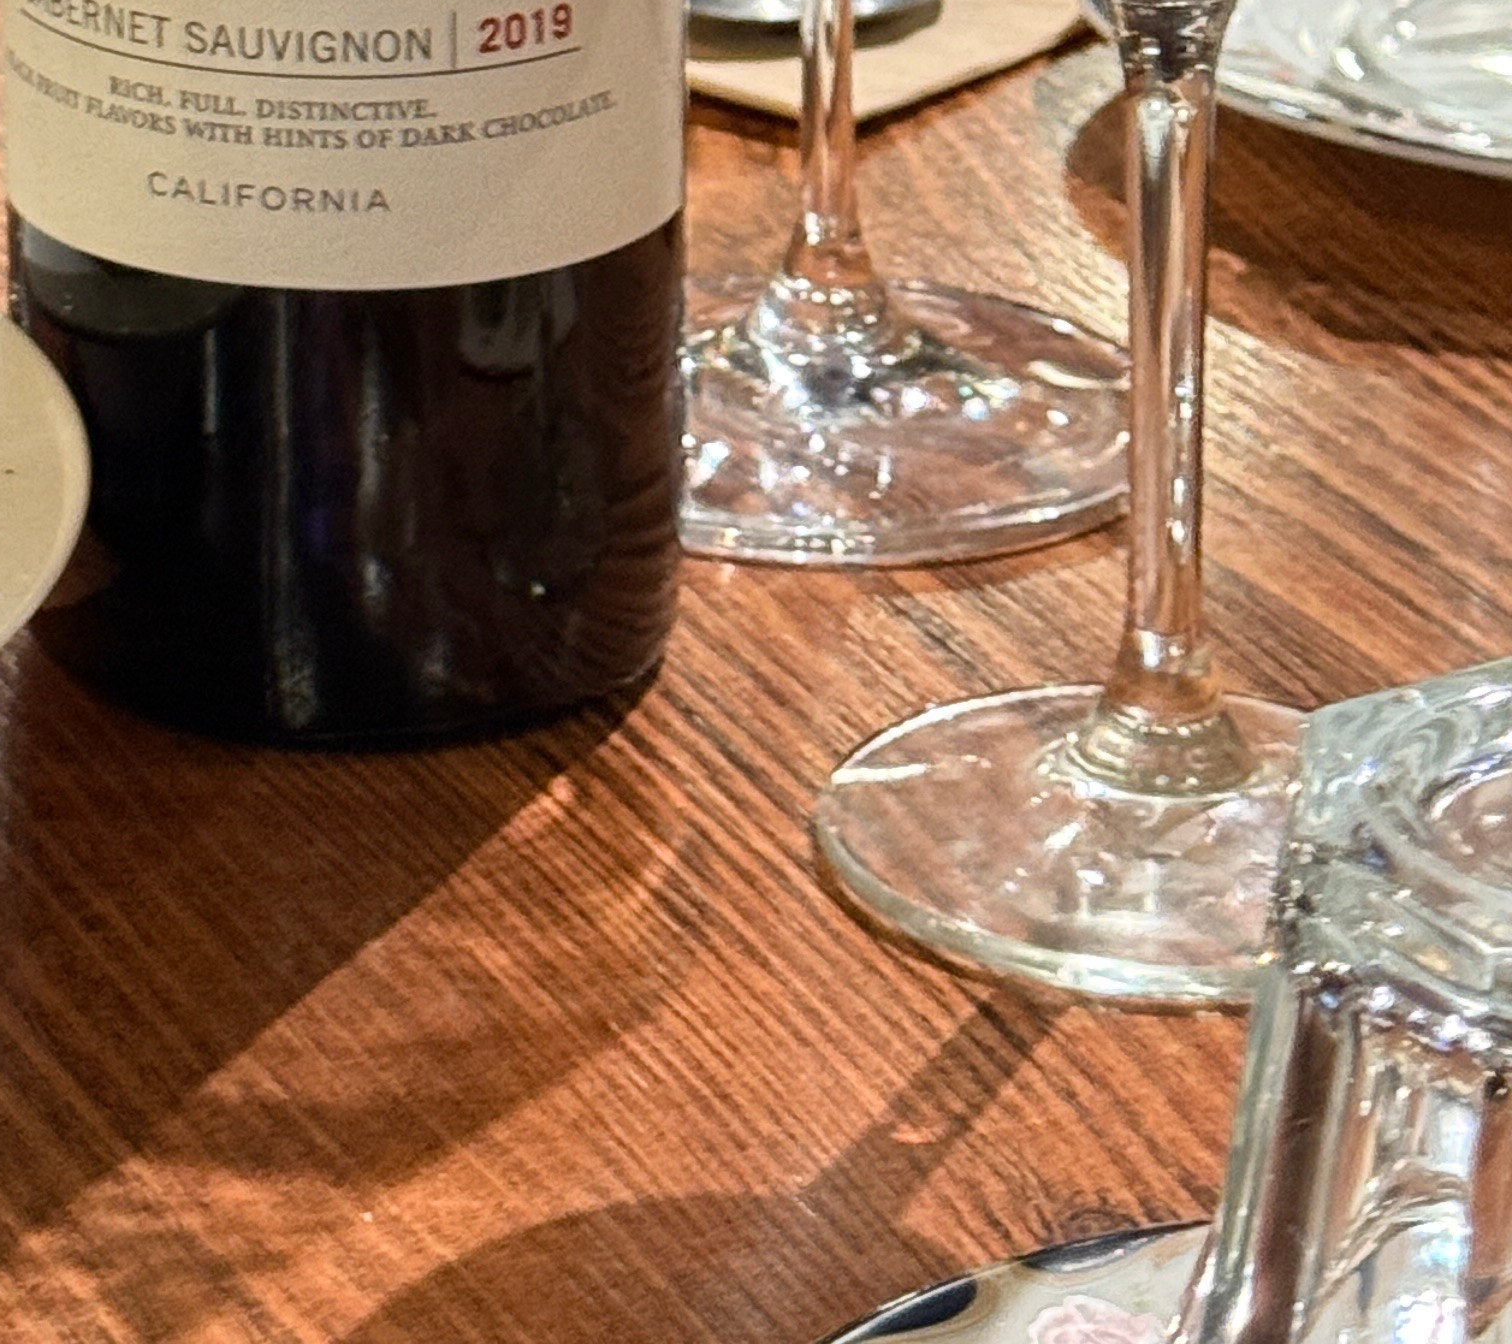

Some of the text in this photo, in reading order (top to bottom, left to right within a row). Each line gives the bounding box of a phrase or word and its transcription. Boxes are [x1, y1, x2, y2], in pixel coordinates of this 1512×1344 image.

[184, 20, 433, 63] SAUVIGNON
[477, 2, 574, 54] 2019
[182, 118, 254, 146] WITH
[263, 126, 348, 149] HINTS
[356, 128, 393, 149] OF
[400, 120, 476, 148] DARK
[146, 170, 392, 213] CALIFORNIA
